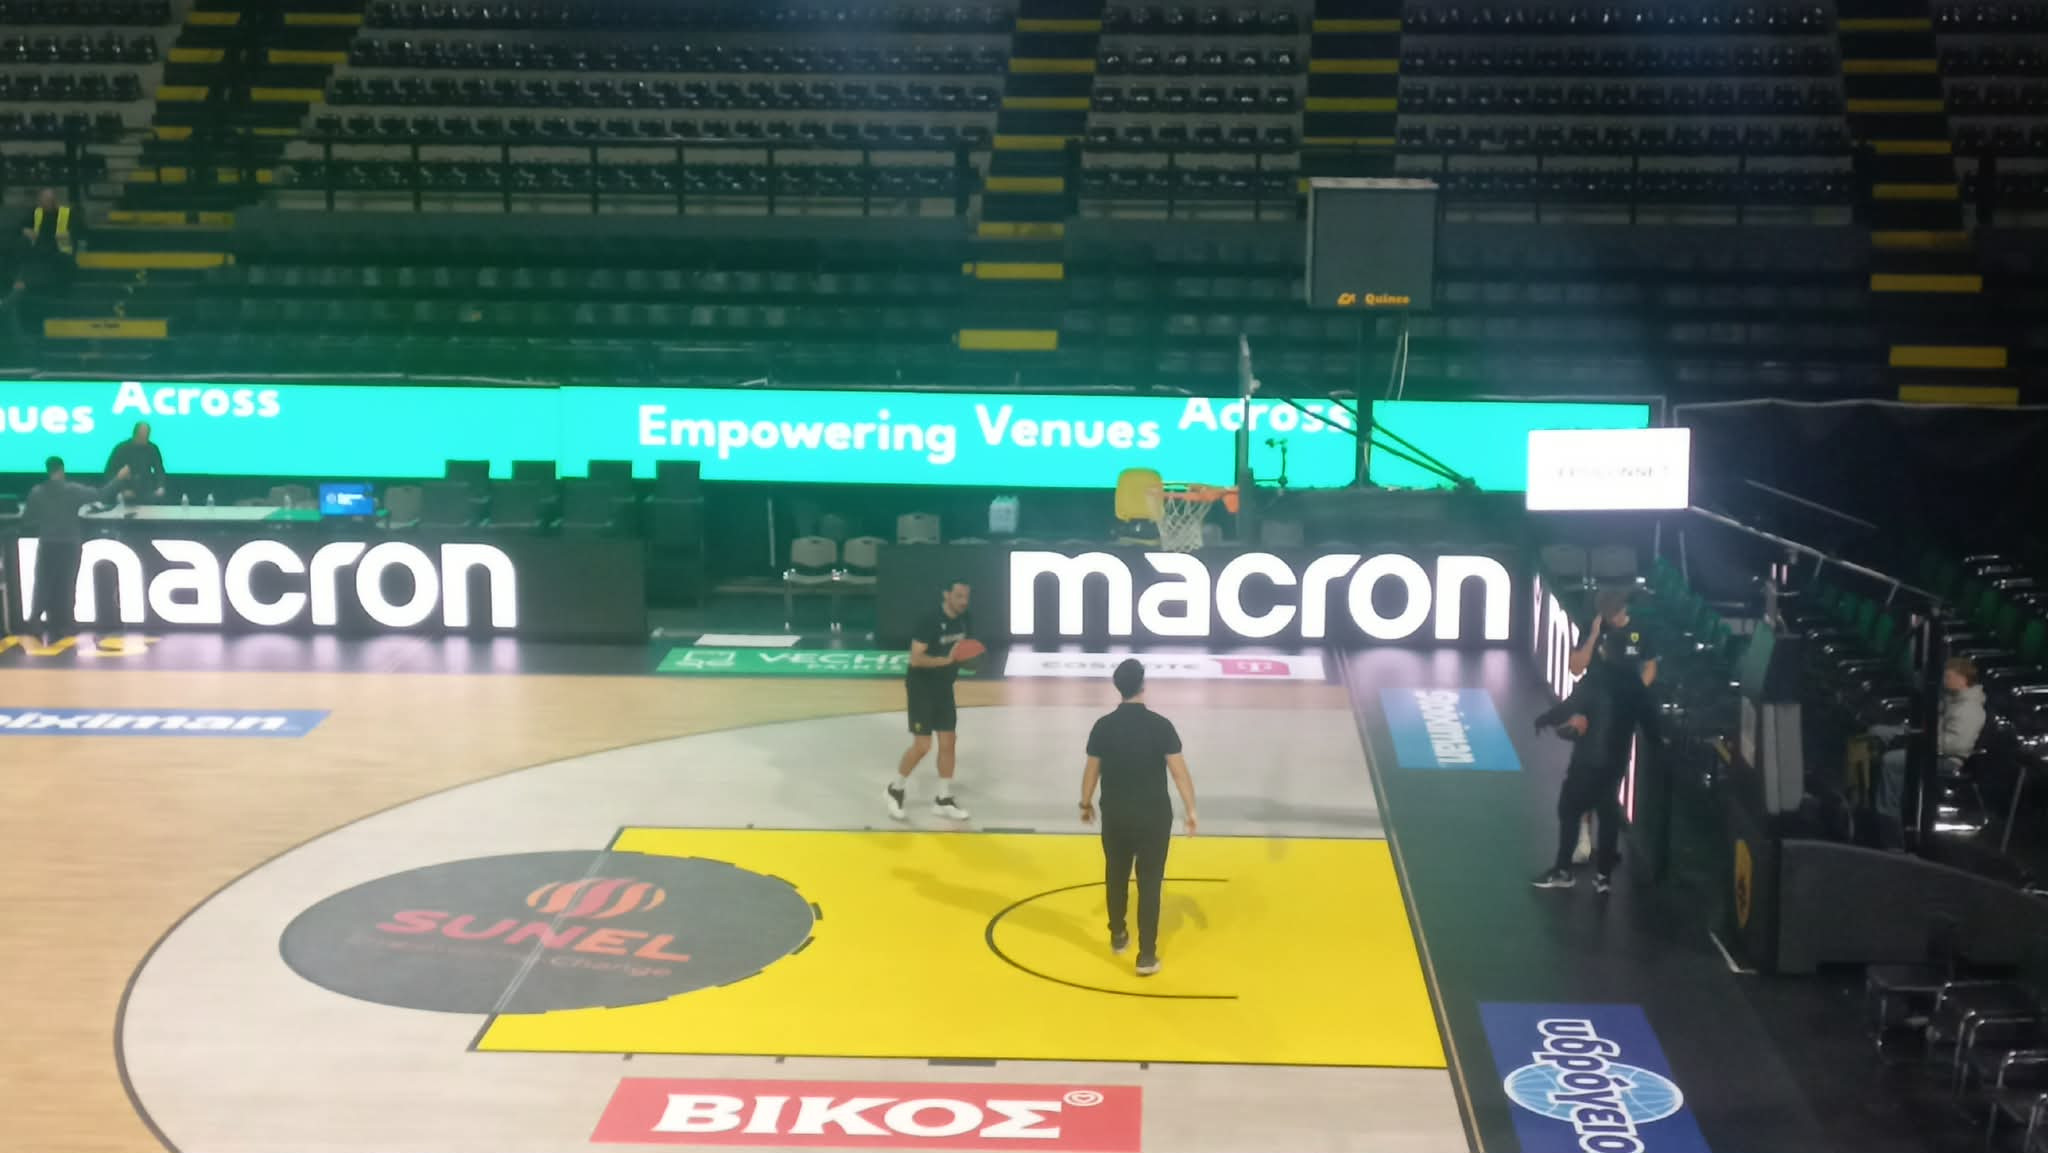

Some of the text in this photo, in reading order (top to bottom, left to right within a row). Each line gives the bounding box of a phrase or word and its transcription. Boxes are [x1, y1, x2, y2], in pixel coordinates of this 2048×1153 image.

[0, 381, 281, 434] ues Across
[639, 397, 1351, 463] Empowering Venues Across
[1010, 551, 1512, 640] macron
[375, 909, 692, 963] SUNEL
[651, 1093, 1063, 1139] ΒΙΚΟΣ
